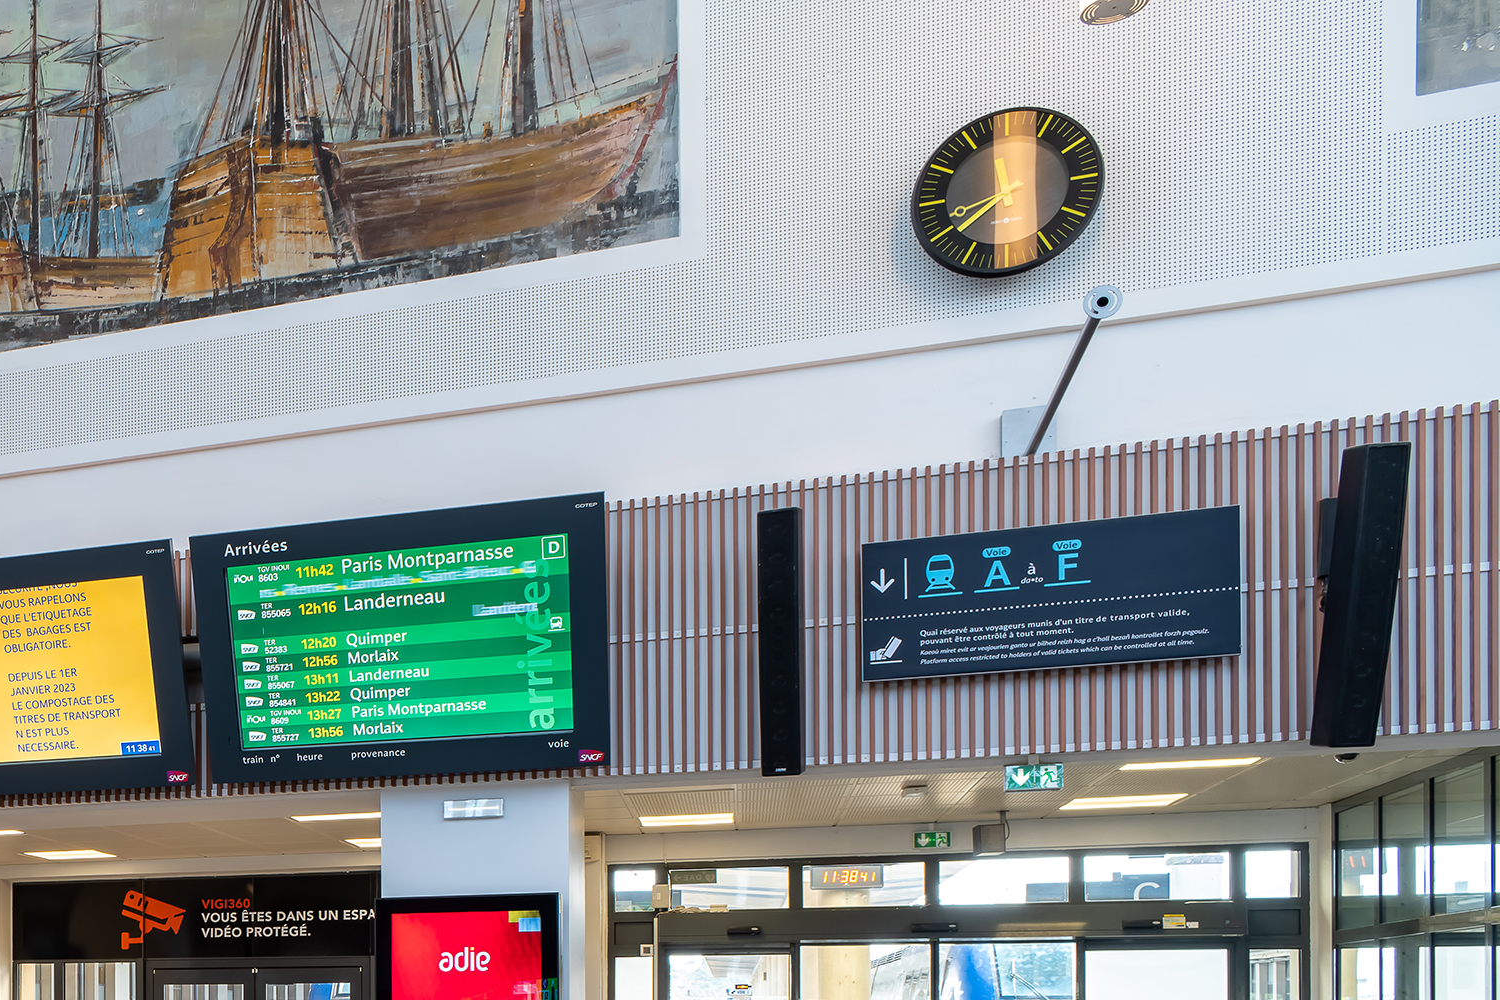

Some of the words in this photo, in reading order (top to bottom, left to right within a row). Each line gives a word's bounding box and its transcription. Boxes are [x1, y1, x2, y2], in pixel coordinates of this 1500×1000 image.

[224, 540, 288, 557] Arrivées
[985, 548, 1007, 556] Voie
[258, 573, 279, 582] 8603
[295, 563, 334, 578] 11h42
[341, 556, 383, 574] Paris
[387, 545, 514, 570] Montparnasse
[984, 560, 1011, 587] A
[1027, 562, 1036, 575] à
[1058, 552, 1079, 580] F
[28, 592, 87, 607] RAPPELONS
[261, 609, 291, 619] 855065
[298, 601, 337, 615] 12h16
[344, 591, 445, 612] Landerneau
[0, 613, 21, 625] QUE
[24, 607, 92, 622] L'ETIQUETAGE
[920, 629, 938, 637] Quai
[940, 626, 968, 635] réservé
[985, 622, 1026, 632] voyageurs
[1028, 619, 1052, 628] munis
[1055, 618, 1073, 626] d'un
[1075, 616, 1094, 624] titre
[1096, 615, 1107, 623] de
[1110, 611, 1155, 621] transport
[1158, 608, 1190, 618] valide,
[2, 629, 21, 639] DES
[26, 624, 71, 637] BAGAGES
[74, 622, 92, 632] EST
[920, 637, 953, 646] pouvant
[954, 634, 971, 643] être
[973, 632, 1007, 641] contrôlé
[1016, 628, 1034, 637] tout
[1036, 627, 1074, 636] moment.
[3, 639, 71, 653] OBLIGATOIRE.
[301, 636, 337, 649] 12h20
[346, 630, 408, 646] Quimper
[515, 558, 555, 729] arrivées
[266, 663, 293, 672] 855721
[302, 655, 338, 668] 12h56
[347, 649, 399, 664] Morlaix
[920, 657, 947, 665] Platform
[970, 653, 1000, 661] restricted
[1057, 647, 1079, 655] tickets
[1124, 641, 1157, 649] controlled
[8, 670, 43, 682] DEPUIS
[59, 668, 77, 678] 1ER
[304, 673, 339, 685] 13h11
[349, 667, 429, 683] Landerneau
[10, 685, 51, 697] JANVIER
[53, 683, 76, 693] 2023
[305, 690, 341, 703] 13h22
[350, 686, 411, 701] Quimper
[25, 696, 93, 710] COMPOSTAGE
[95, 694, 115, 704] DES
[306, 708, 342, 721] 13h27
[351, 705, 384, 718] Paris
[388, 700, 486, 716] Montparnasse
[14, 714, 45, 725] TITRES
[63, 708, 121, 722] TRANSPORT
[45, 727, 70, 737] PLUS
[308, 726, 344, 738] 13h56
[352, 722, 404, 736] Morlaix
[823, 870, 858, 883] 11:38
[860, 870, 877, 882] 41
[202, 898, 250, 909] VIGI360
[201, 912, 237, 923] VOUS
[242, 910, 272, 923] ÊTES
[277, 910, 314, 922] DANS
[318, 910, 338, 921] UN
[201, 925, 242, 938] VIDÉO
[246, 923, 311, 938] PROTÉGÉ.
[439, 946, 491, 972] adie
